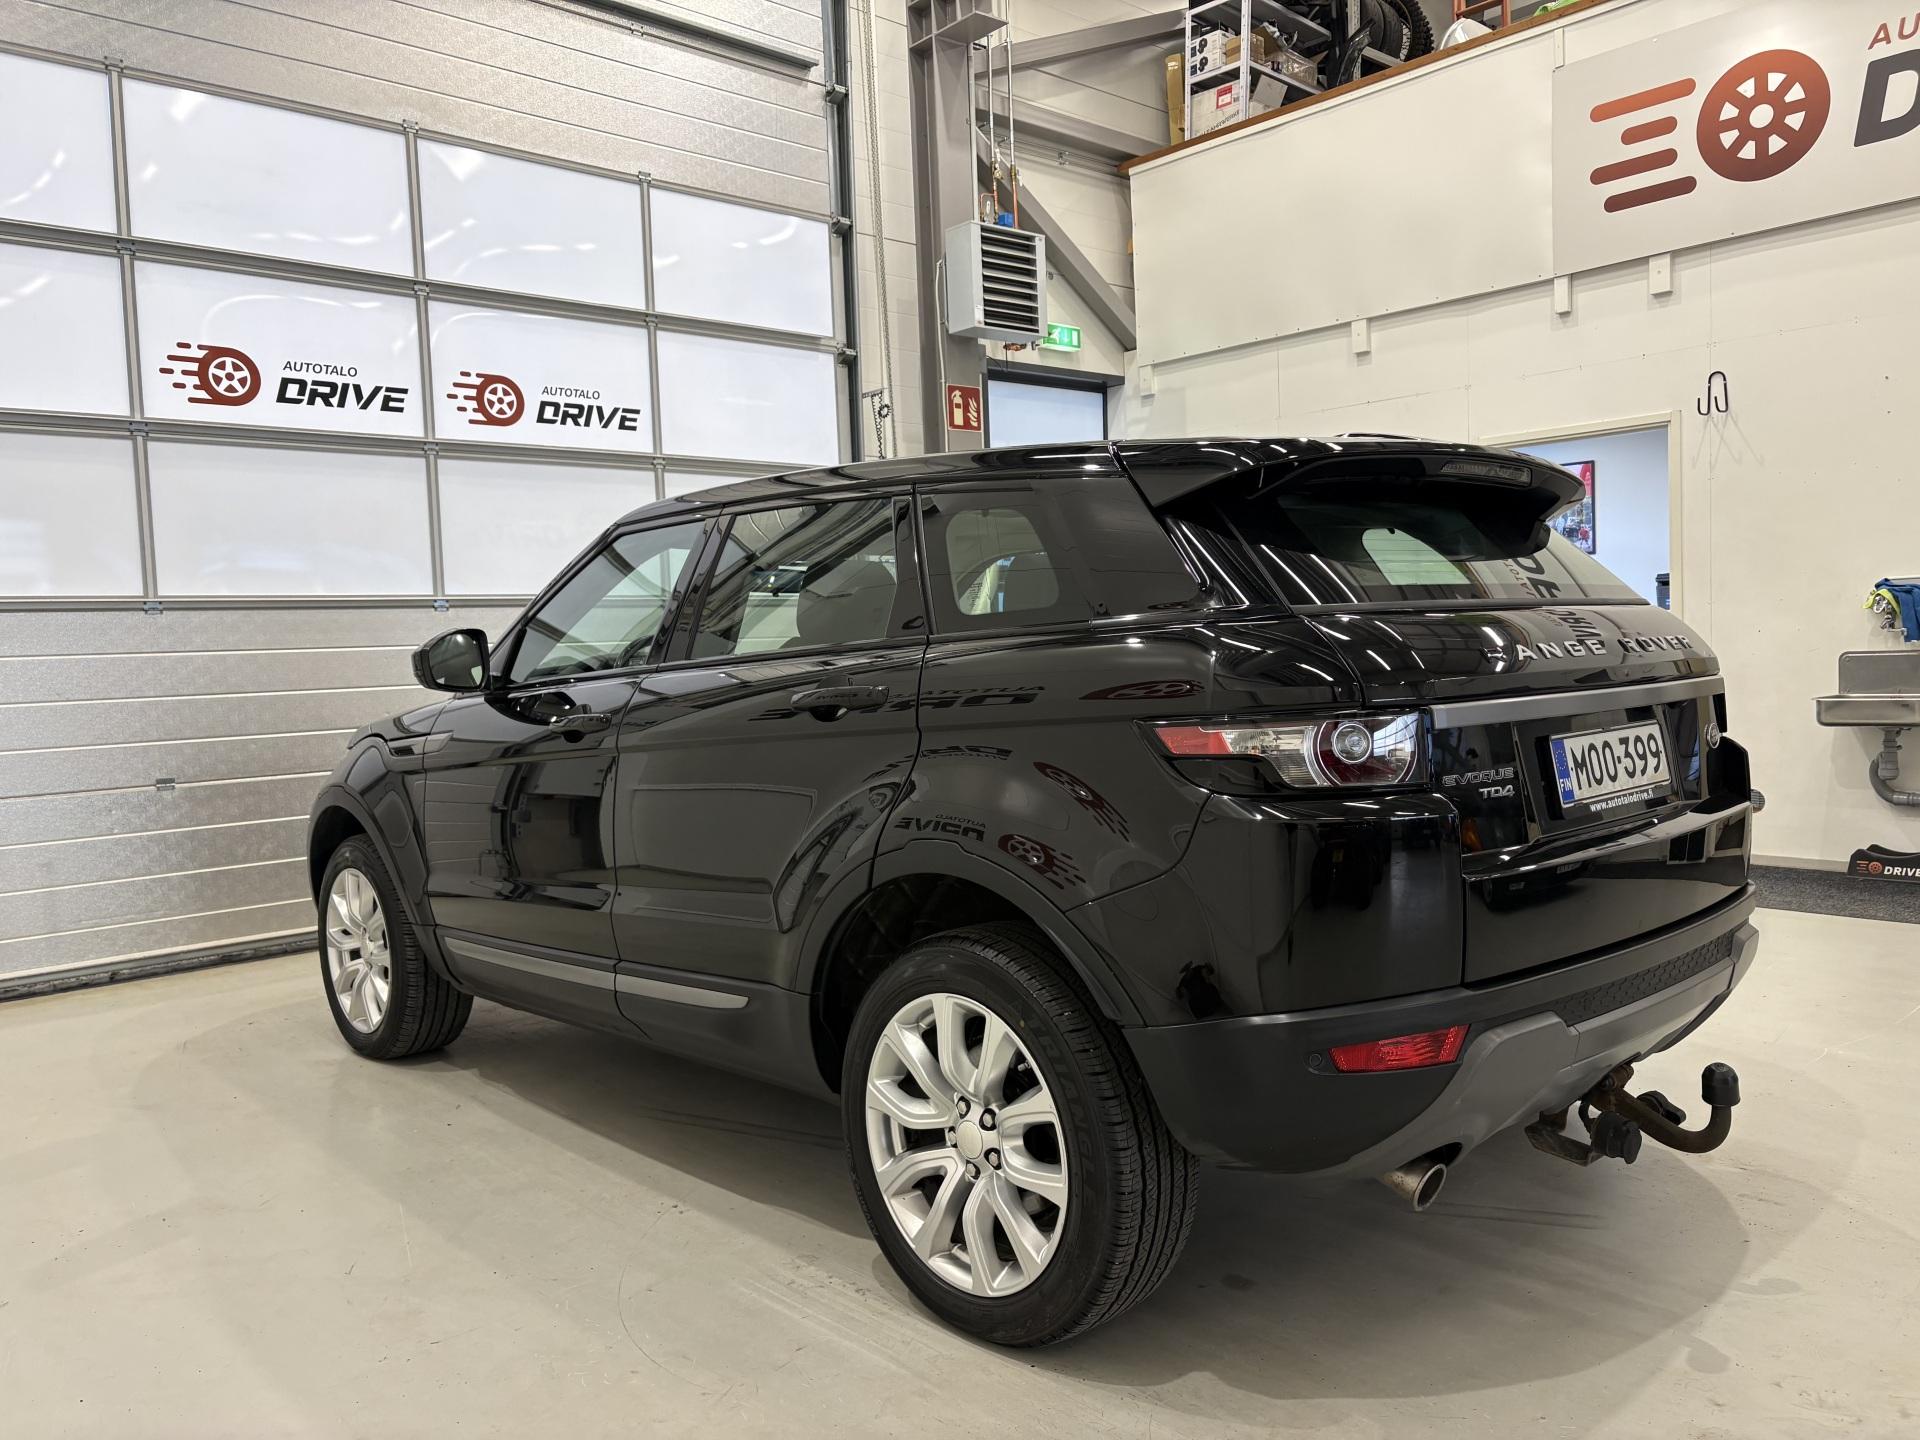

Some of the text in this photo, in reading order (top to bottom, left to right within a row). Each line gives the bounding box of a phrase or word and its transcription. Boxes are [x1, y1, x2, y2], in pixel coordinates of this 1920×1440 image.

[283, 360, 358, 377] AUTOTALO
[275, 377, 409, 413] DRIVE
[541, 386, 601, 400] AUTOTALO
[536, 400, 641, 431] DRIVE
[1618, 634, 1693, 653] ROVER
[1570, 733, 1661, 791] MOO-399
[1442, 767, 1515, 787] EVOQUE
[1560, 778, 1572, 793] FIN
[1479, 784, 1515, 799] TD4
[1589, 789, 1654, 812] www.autotalodrive.fi
